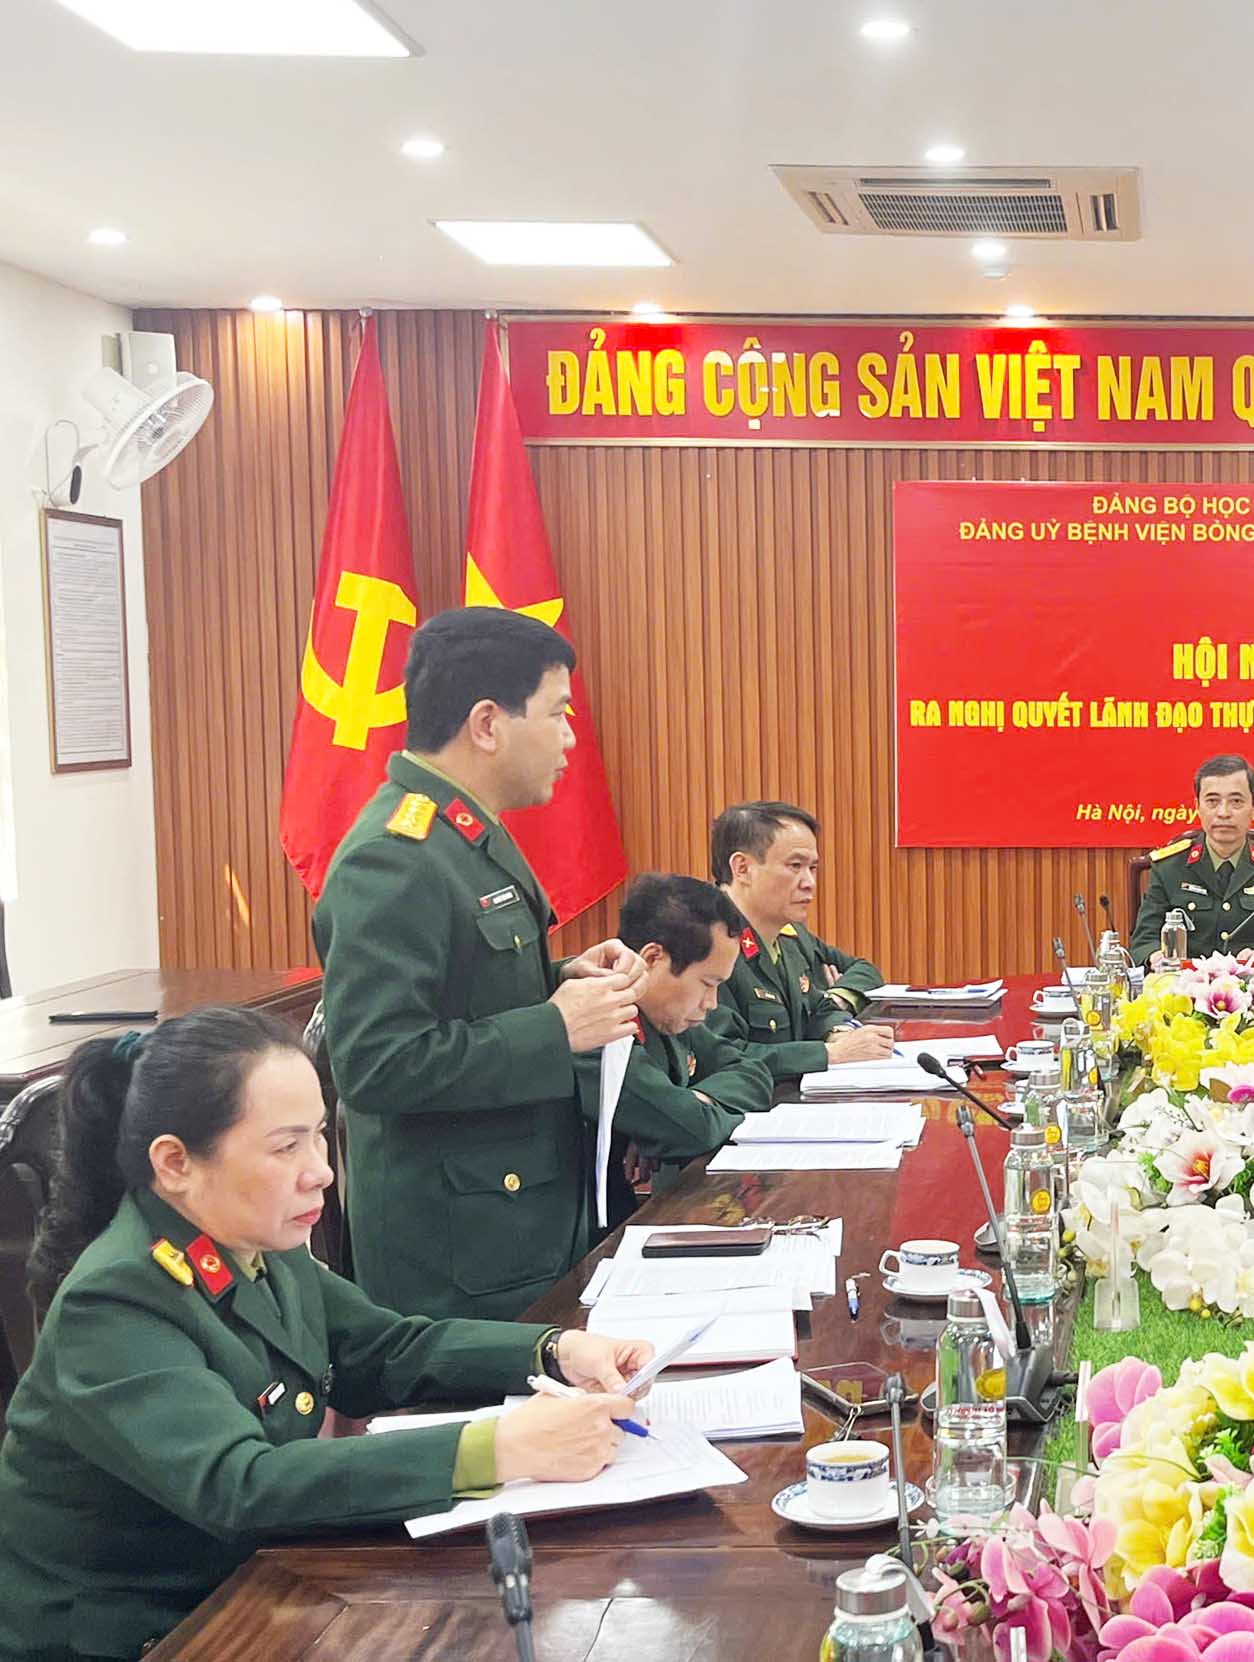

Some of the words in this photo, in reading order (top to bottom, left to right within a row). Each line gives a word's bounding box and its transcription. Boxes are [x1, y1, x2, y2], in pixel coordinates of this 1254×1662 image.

[546, 328, 686, 417] ĐẢNG
[702, 337, 841, 430] CỘNG
[857, 331, 960, 419] SẢN
[975, 340, 1081, 433] VIỆT
[1097, 355, 1214, 421] NAM
[1092, 492, 1157, 515] ĐẢNG
[1163, 494, 1196, 519] BỘ
[1202, 496, 1251, 519] HỌC
[959, 518, 1024, 540] ĐẢNG
[1031, 518, 1061, 541] UỶ
[1067, 520, 1129, 545] BỆNH
[1135, 521, 1185, 545] VIỆN
[1172, 636, 1228, 688] HỘI
[910, 699, 942, 727] RA
[948, 700, 1005, 733] NGHỊ
[1012, 691, 1084, 729] QUYẾT
[1089, 696, 1149, 728] LÃNH
[1155, 701, 1204, 733] ĐẠO
[1076, 803, 1103, 820] Hà
[1107, 802, 1145, 825] Nội,
[1151, 803, 1200, 825] ngày
